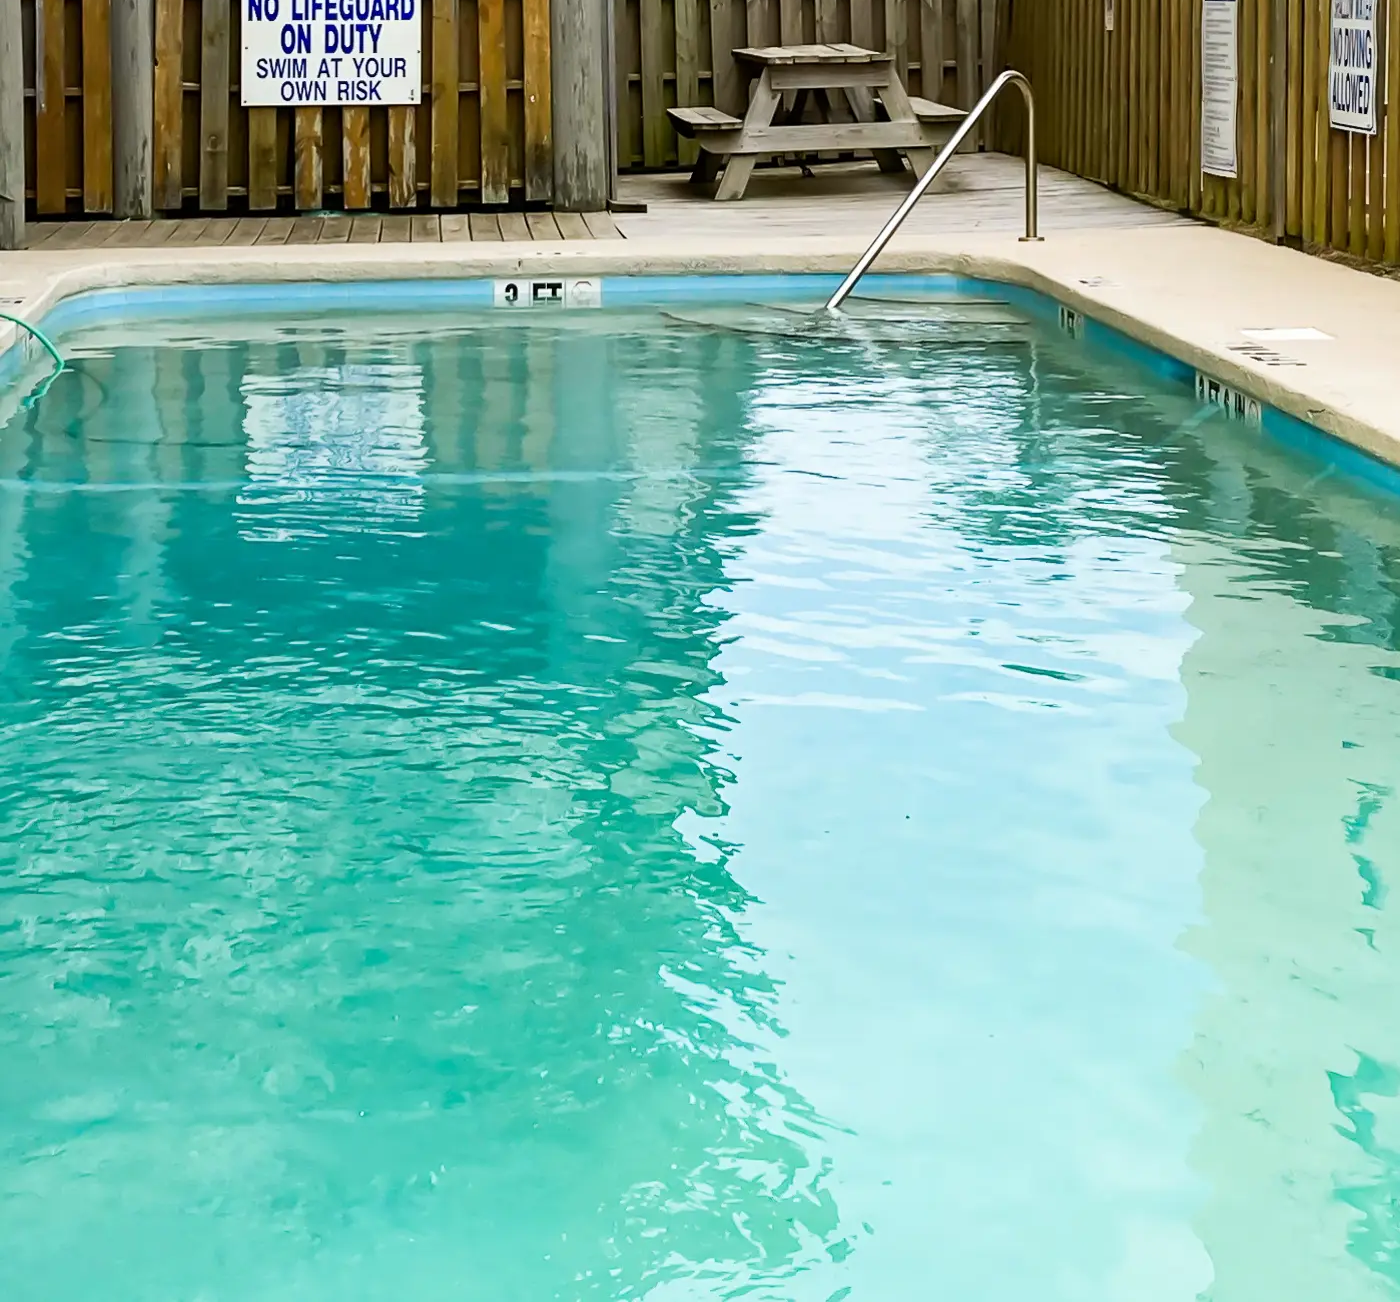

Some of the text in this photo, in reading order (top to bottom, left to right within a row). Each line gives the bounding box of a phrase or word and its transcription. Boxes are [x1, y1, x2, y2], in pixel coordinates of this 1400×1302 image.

[280, 23, 383, 54] ON DUTY
[1333, 27, 1372, 69] NO DIVING
[256, 57, 407, 79] SWIM AT YOUR
[280, 80, 382, 101] OWN RISK
[1332, 71, 1371, 115] ALLOWED
